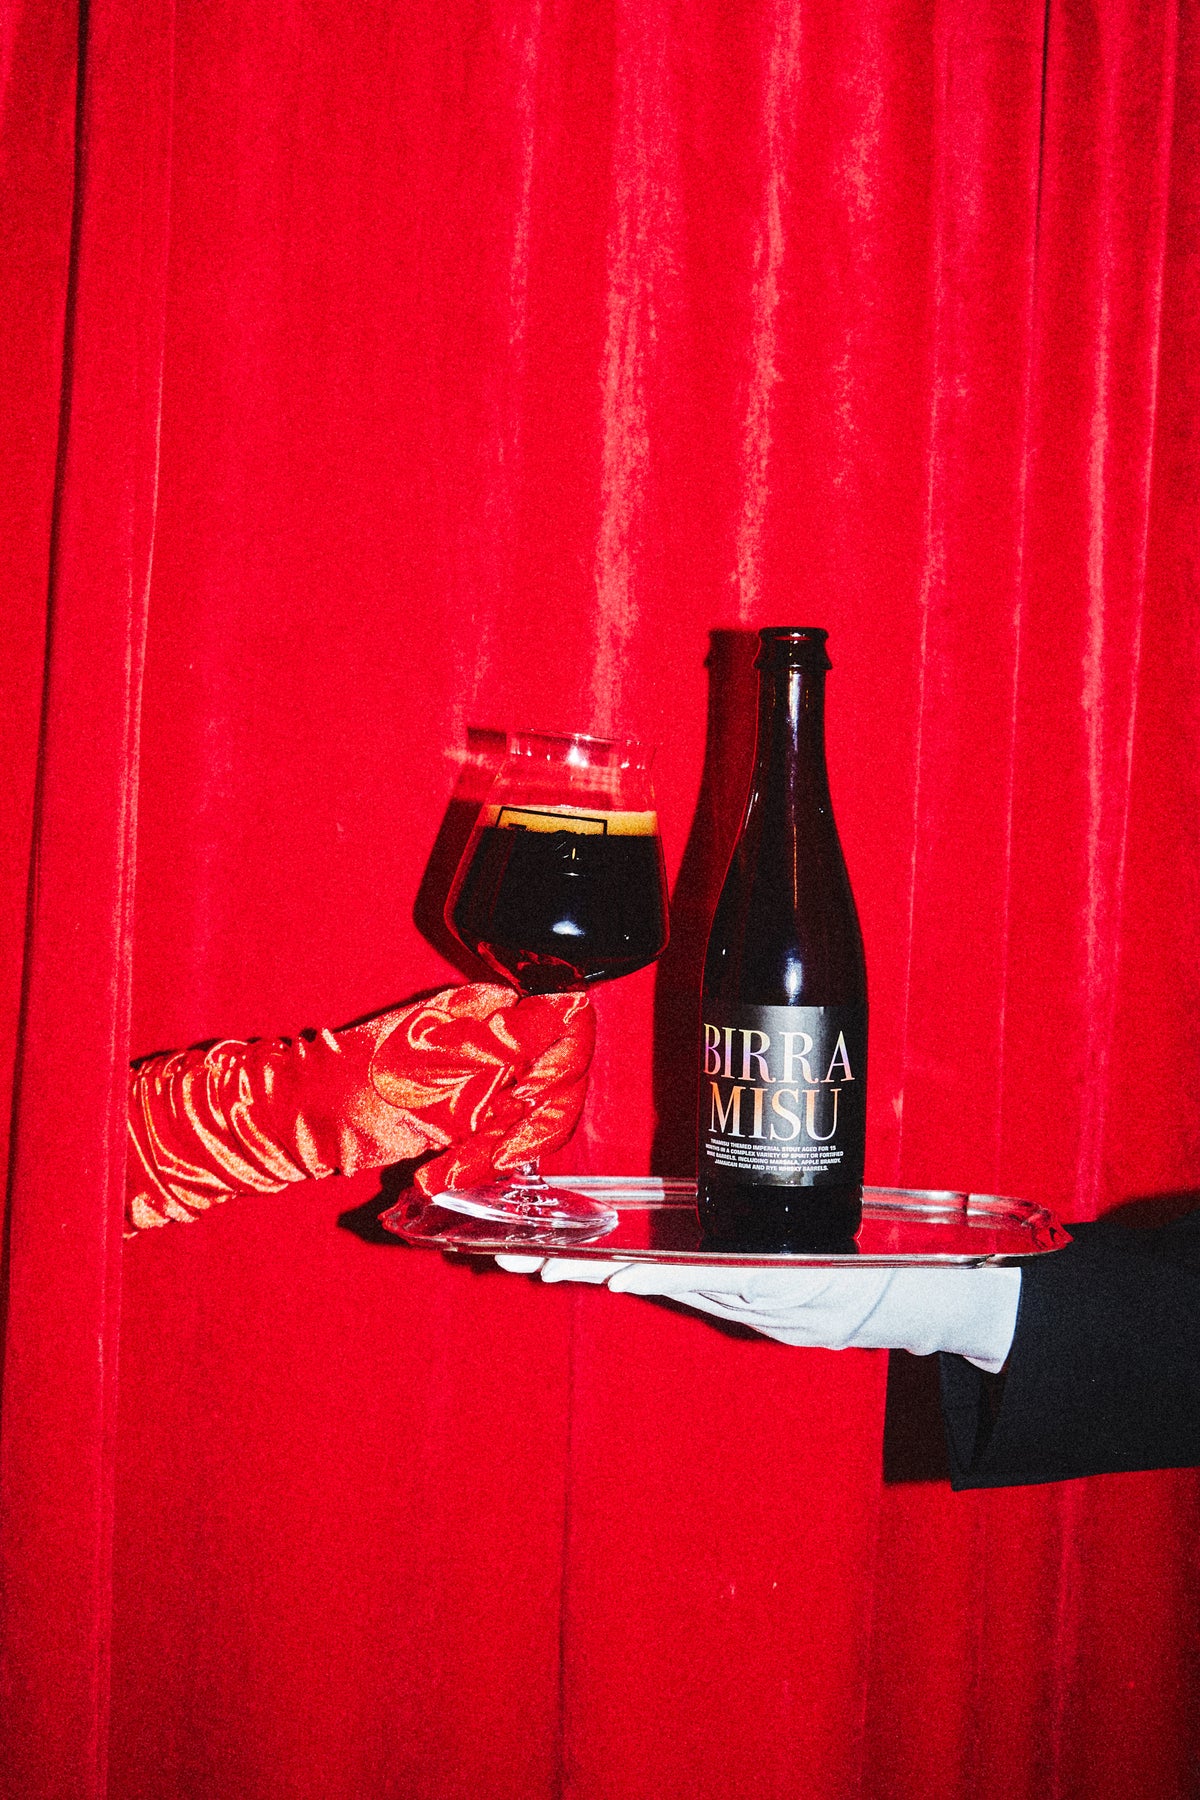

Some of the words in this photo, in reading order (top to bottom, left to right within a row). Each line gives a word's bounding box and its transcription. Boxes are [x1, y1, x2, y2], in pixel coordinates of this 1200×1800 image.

[703, 1023, 855, 1083] BIRRA
[708, 1081, 842, 1141] MISU
[752, 1144, 780, 1152] IMPERIAL
[730, 1148, 756, 1157] COMPLEX
[714, 1159, 738, 1167] JAMAICAN
[737, 1156, 769, 1164] INCLUDING
